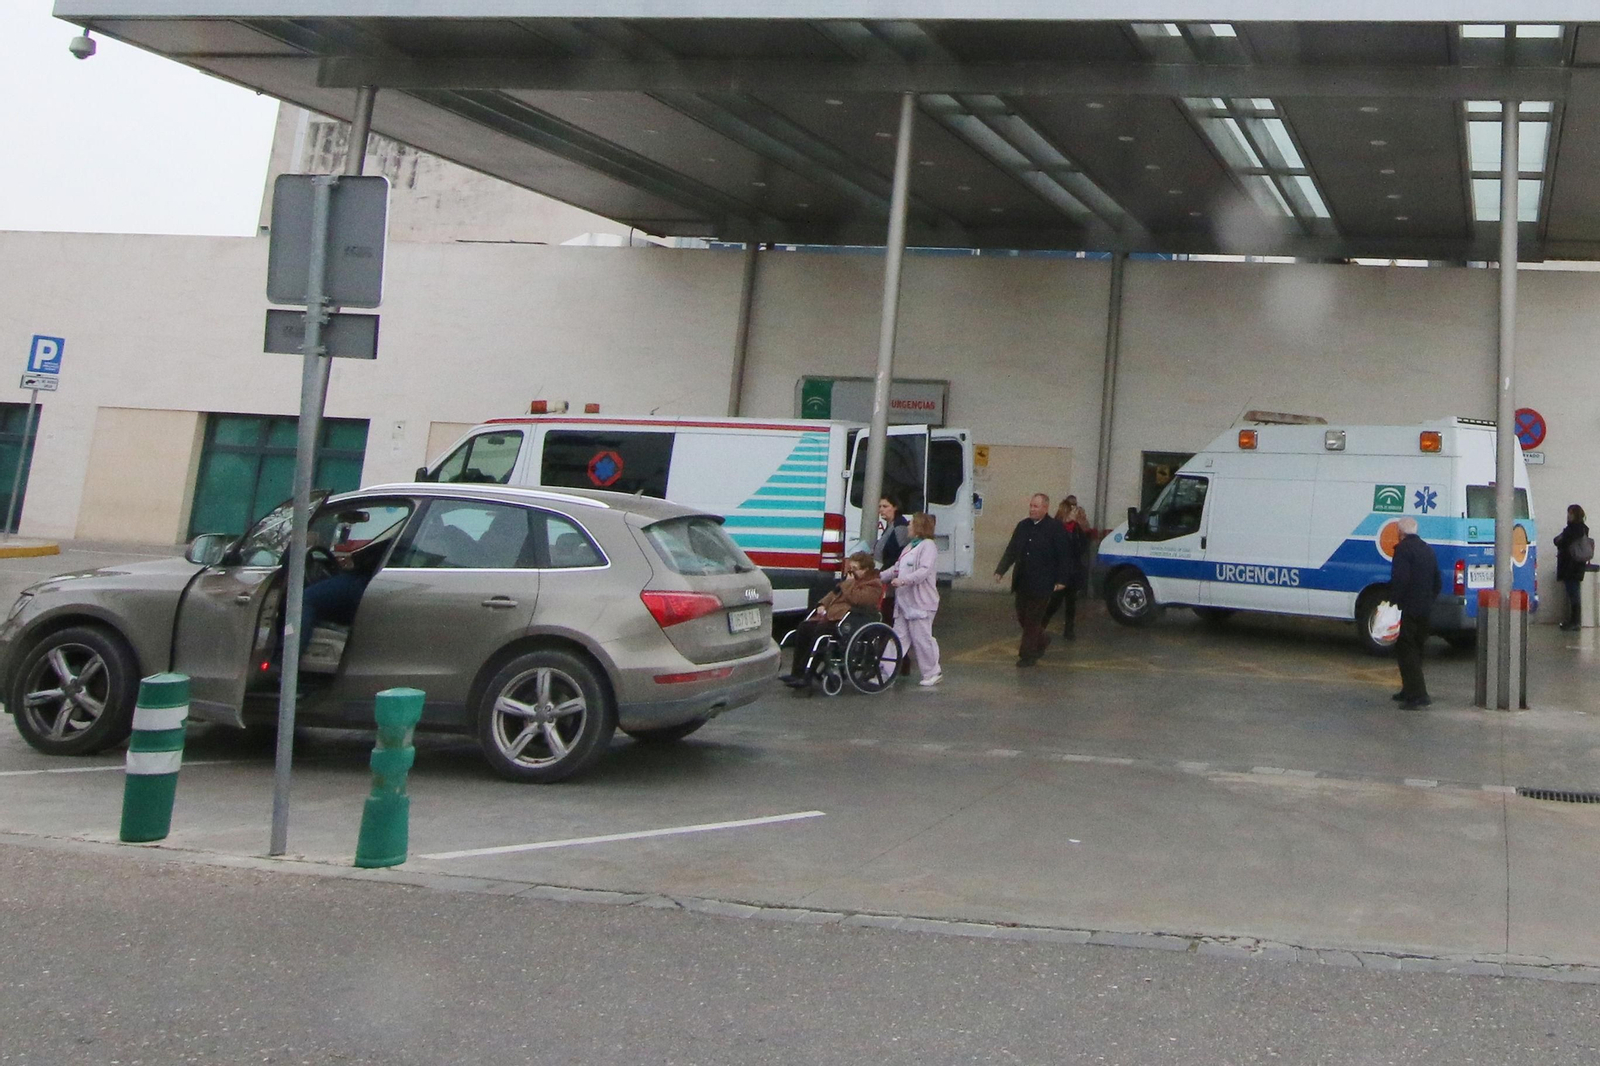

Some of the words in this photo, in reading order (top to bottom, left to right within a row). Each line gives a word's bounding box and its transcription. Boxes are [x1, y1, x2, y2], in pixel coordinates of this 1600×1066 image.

[33, 339, 58, 369] P
[891, 400, 936, 410] URGENCIAS
[1215, 564, 1300, 586] URGENCIAS
